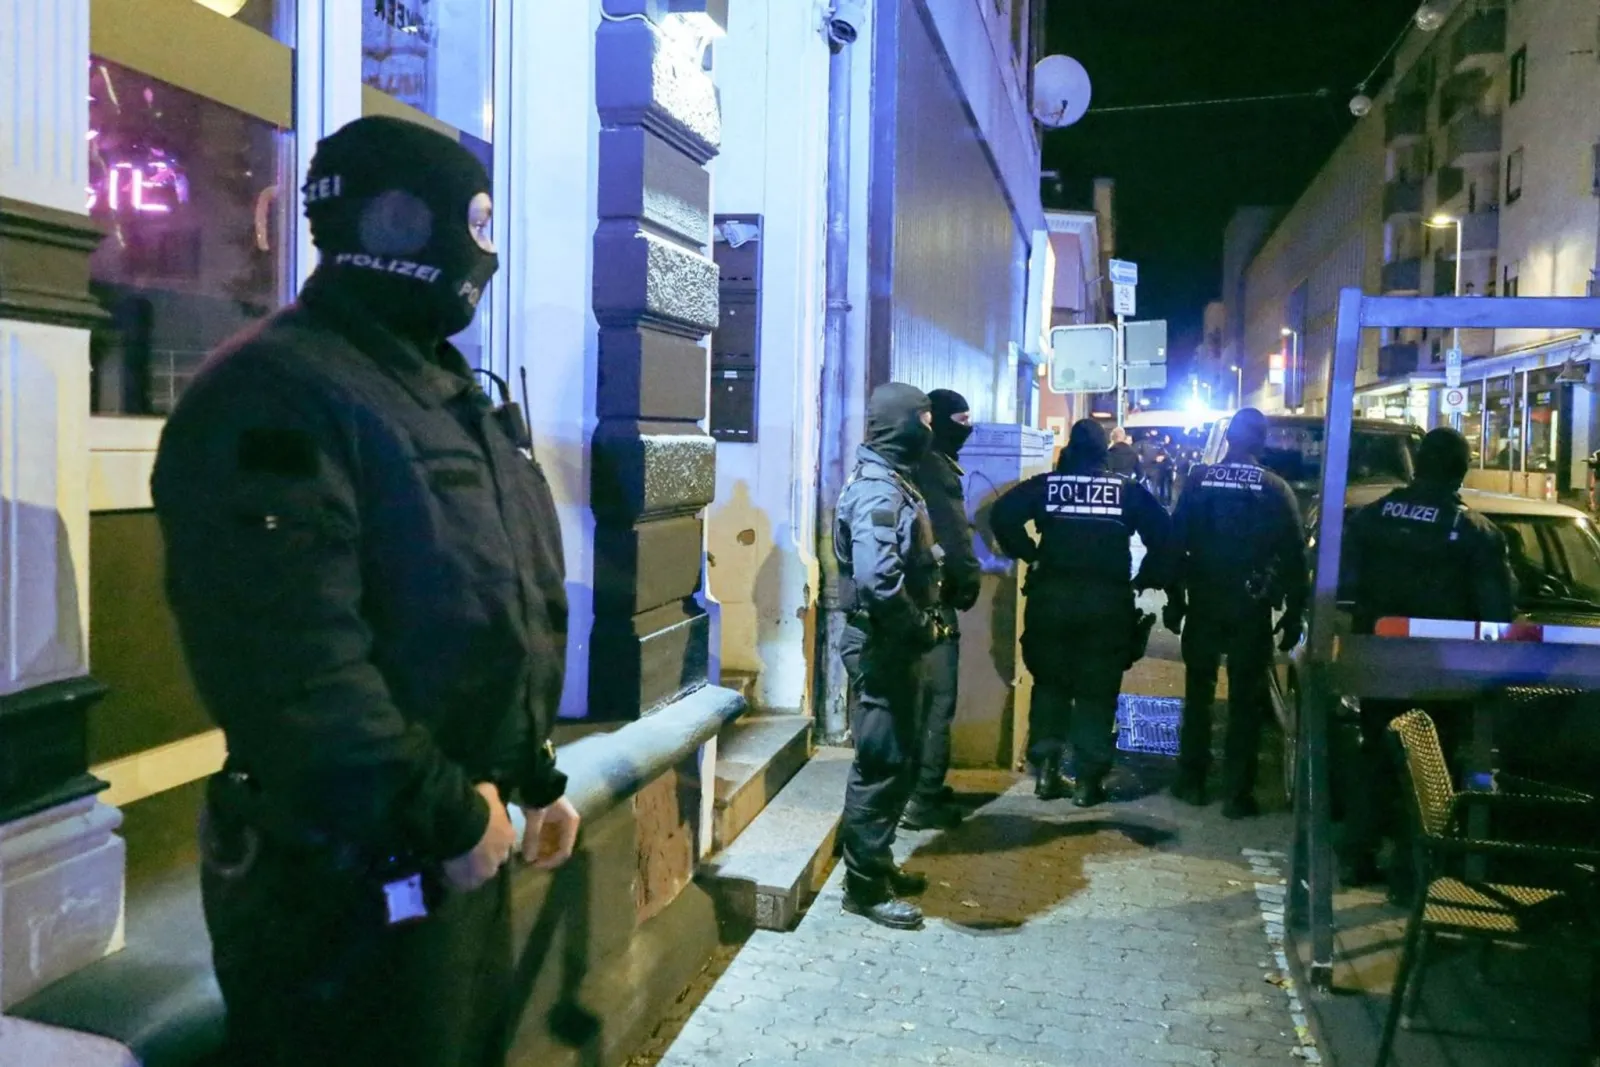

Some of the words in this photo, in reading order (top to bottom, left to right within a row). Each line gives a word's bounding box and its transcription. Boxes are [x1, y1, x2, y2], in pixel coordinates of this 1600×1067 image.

[336, 253, 442, 283] POLIZEI
[1203, 467, 1263, 484] POLIZEI
[1047, 483, 1120, 505] POLIZEI
[1382, 501, 1439, 523] POLIZEI
